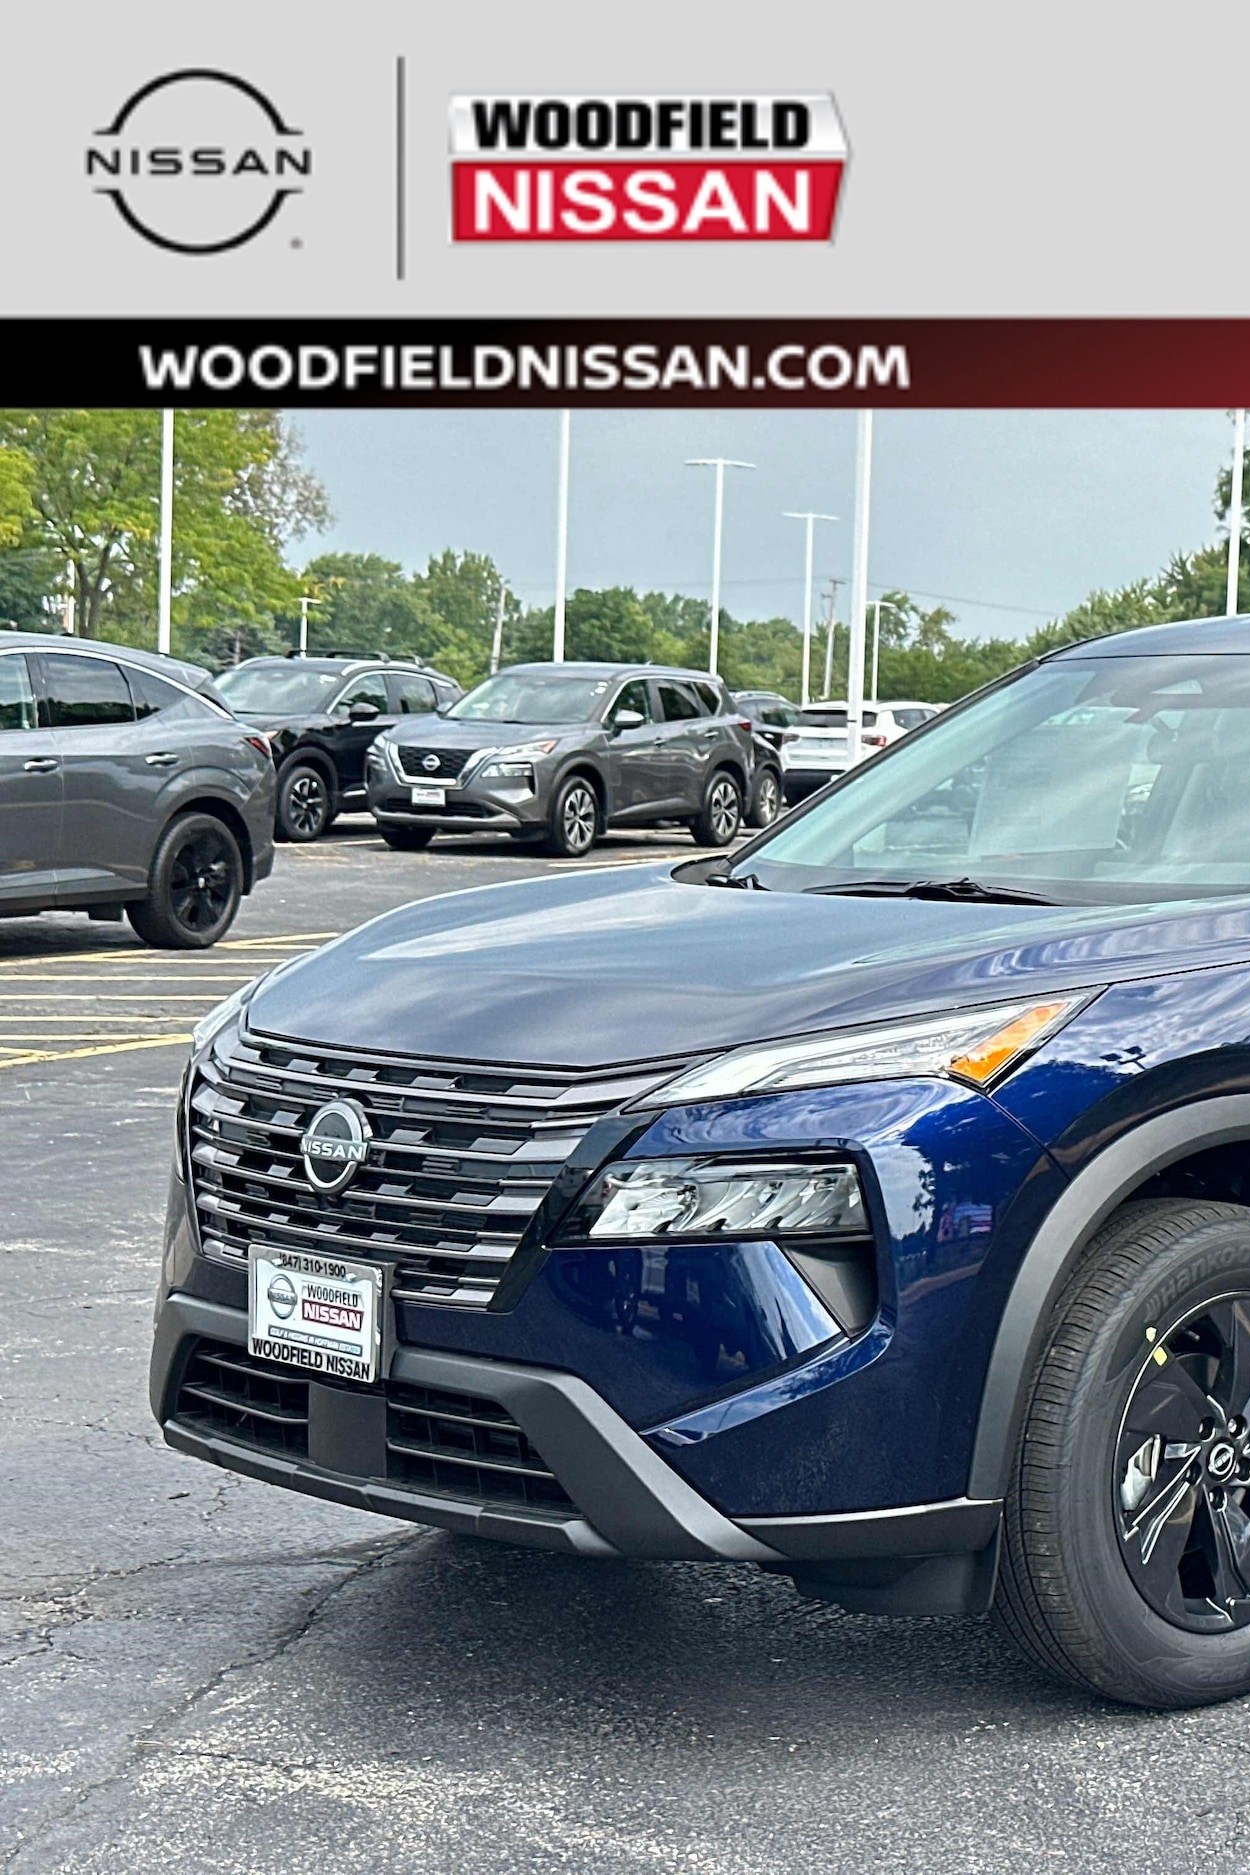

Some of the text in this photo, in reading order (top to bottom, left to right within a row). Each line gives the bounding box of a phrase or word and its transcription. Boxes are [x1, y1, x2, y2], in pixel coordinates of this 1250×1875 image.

[302, 1138, 363, 1160] NISSAN
[303, 1258, 347, 1278] 310-1900
[307, 1284, 358, 1307] WOODFIELD
[304, 1302, 361, 1329] NISSAN
[252, 1338, 323, 1369] WOODFIELD
[326, 1353, 370, 1380] NISSAN
